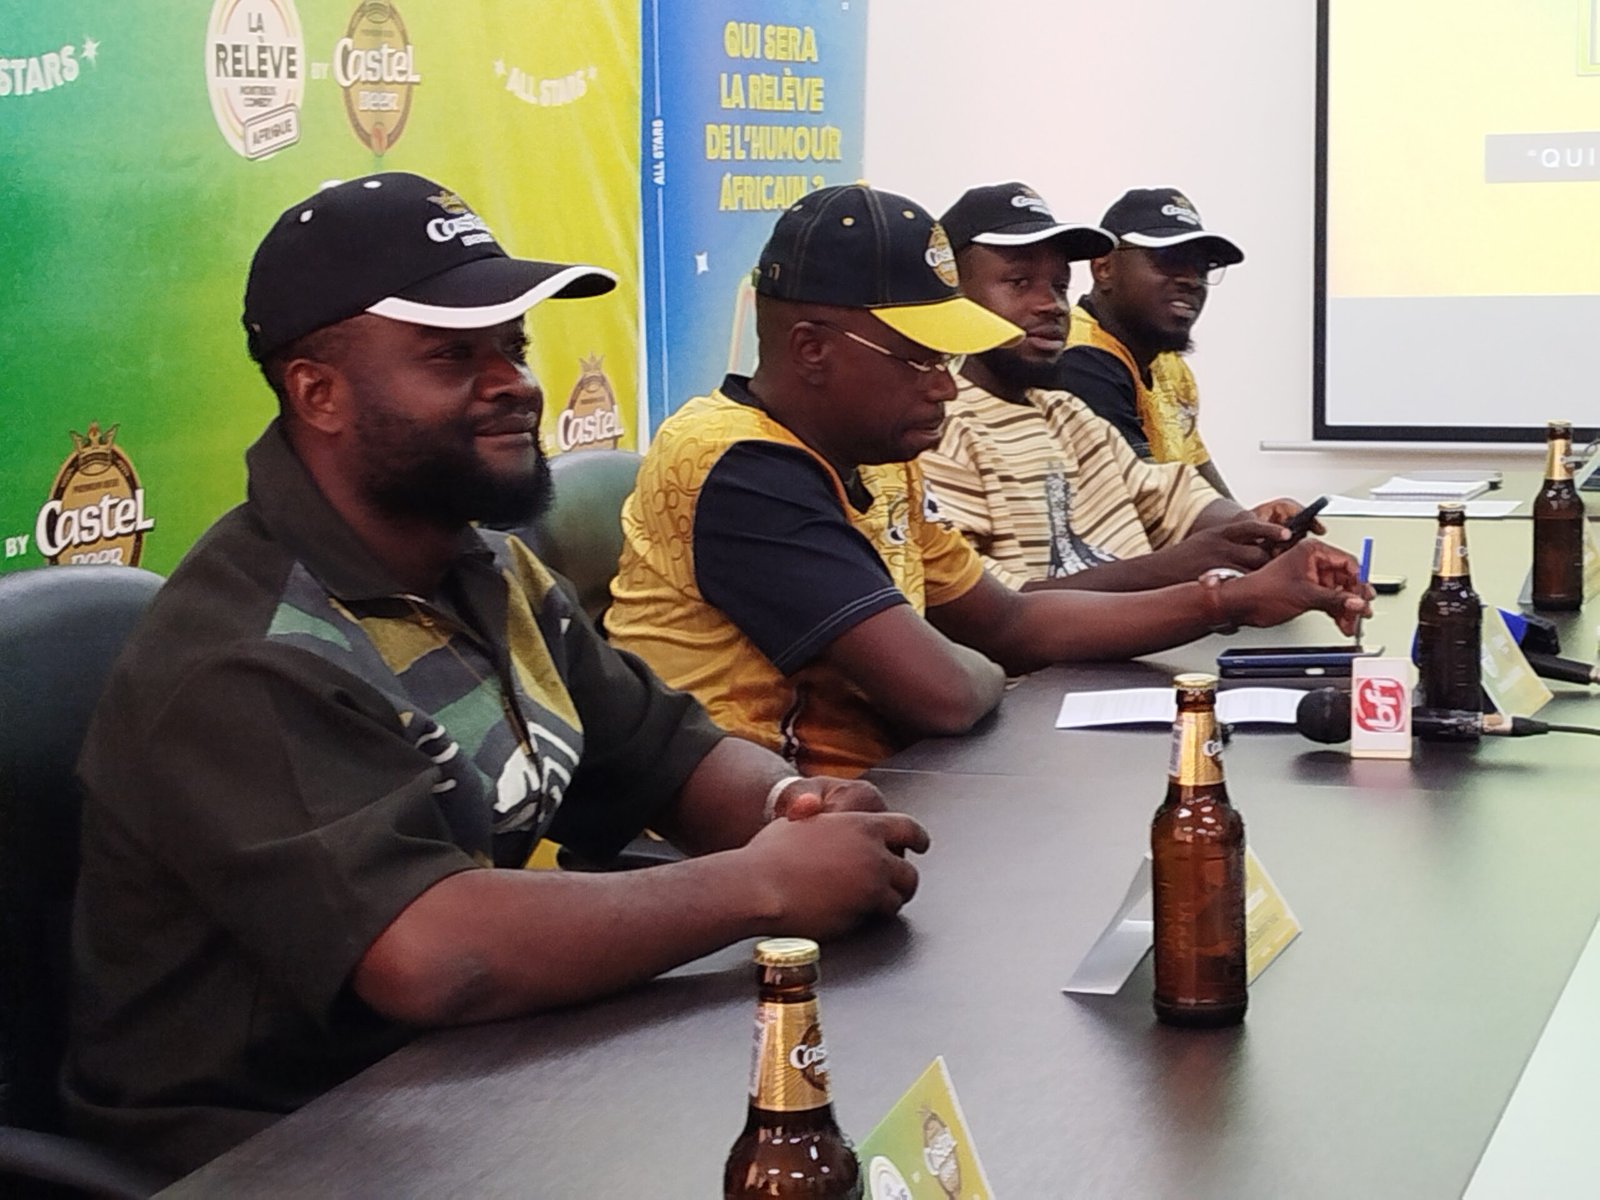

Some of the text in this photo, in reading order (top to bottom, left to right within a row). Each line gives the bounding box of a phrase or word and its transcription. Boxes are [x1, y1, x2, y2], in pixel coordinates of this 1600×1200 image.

[248, 12, 264, 33] LA
[724, 21, 818, 62] QUI SERA
[0, 45, 79, 96] STARS
[215, 36, 298, 79] RELÈVE
[720, 67, 824, 112] LA RELÈVE
[652, 119, 666, 186] ALL STARS
[705, 123, 843, 161] DE L'HUMOUR
[5, 534, 30, 558] BY
